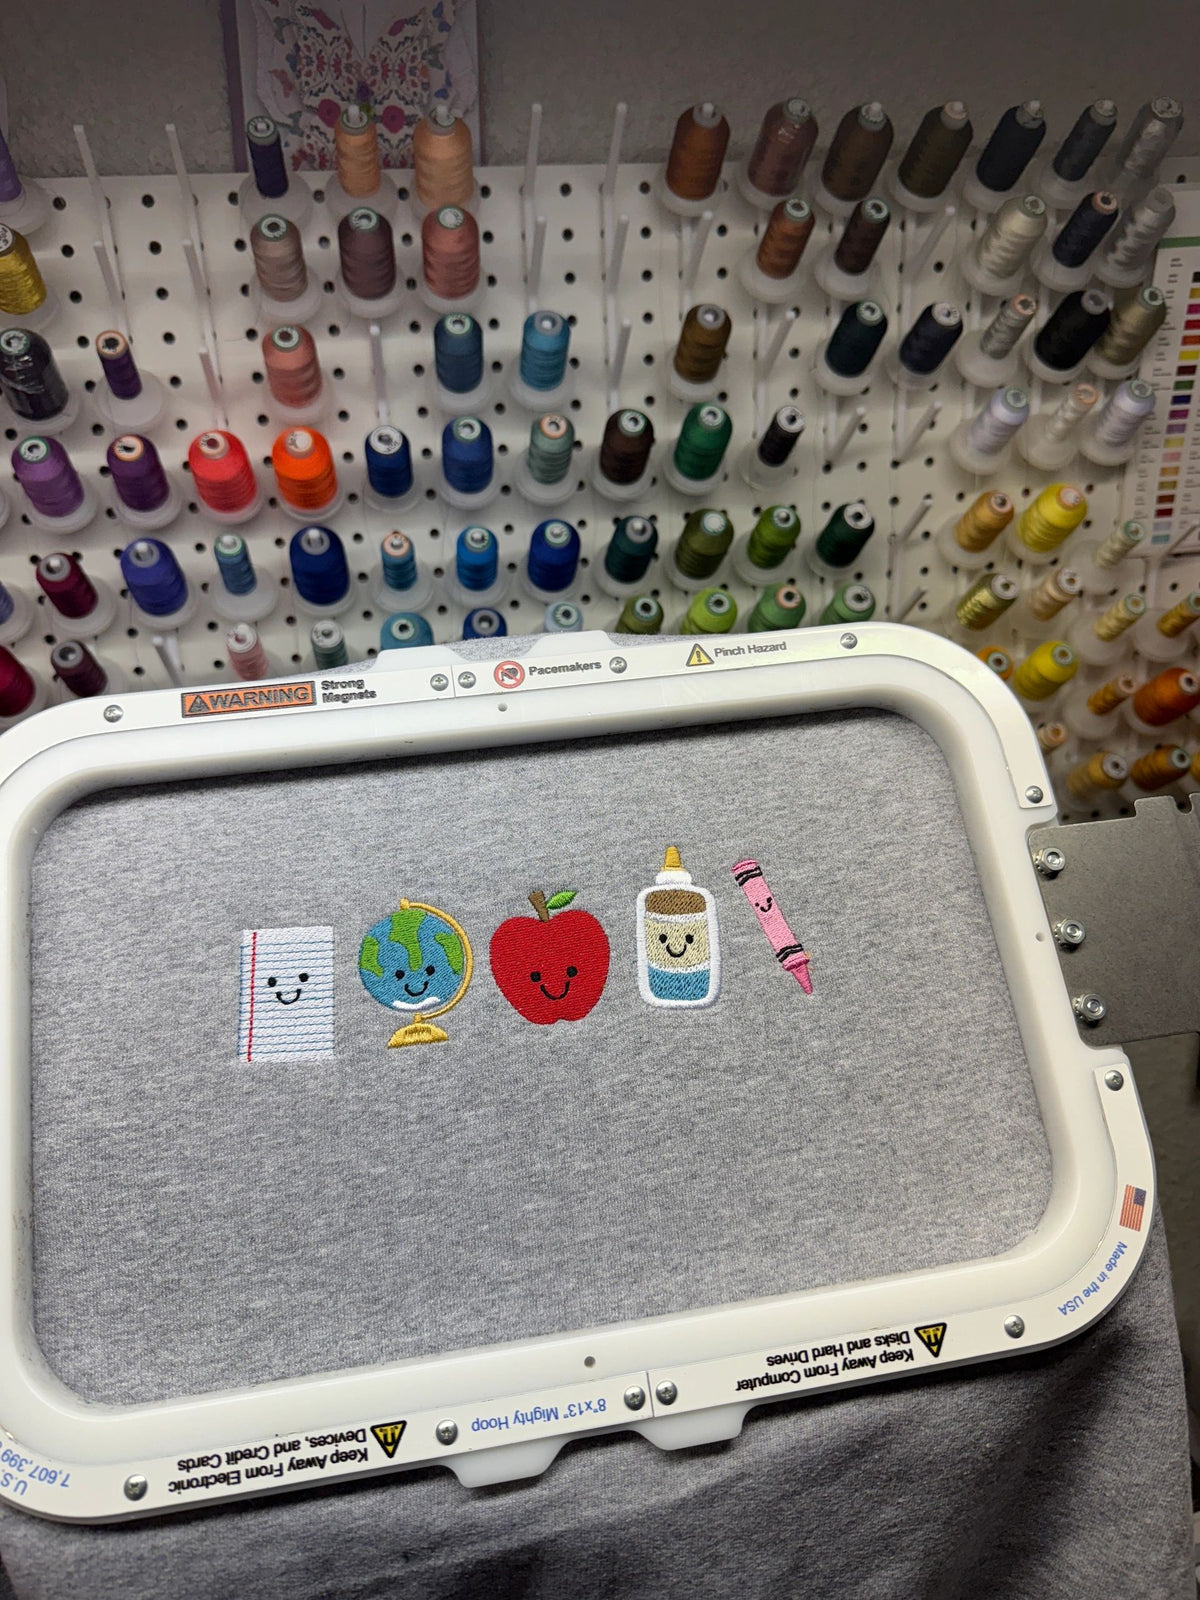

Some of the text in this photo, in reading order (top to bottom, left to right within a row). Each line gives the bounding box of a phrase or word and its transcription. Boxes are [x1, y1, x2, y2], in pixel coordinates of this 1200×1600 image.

[714, 641, 787, 658] Pinch Hazard
[321, 678, 365, 691] Strong
[528, 660, 602, 676] Pacemakers
[209, 686, 309, 709] WARNING
[322, 688, 377, 703] Magnets
[1057, 1241, 1128, 1316] Made in the USA
[766, 1331, 911, 1367] Disks and Hard Drives
[735, 1348, 914, 1392] Keep Away From Computer
[471, 1398, 607, 1431] 8"x13" Mighty Hoop
[177, 1428, 367, 1472] Devices, and Credit Cards
[0, 1448, 70, 1488] 7,607,399
[168, 1447, 369, 1494] Keep Away From Electronic
